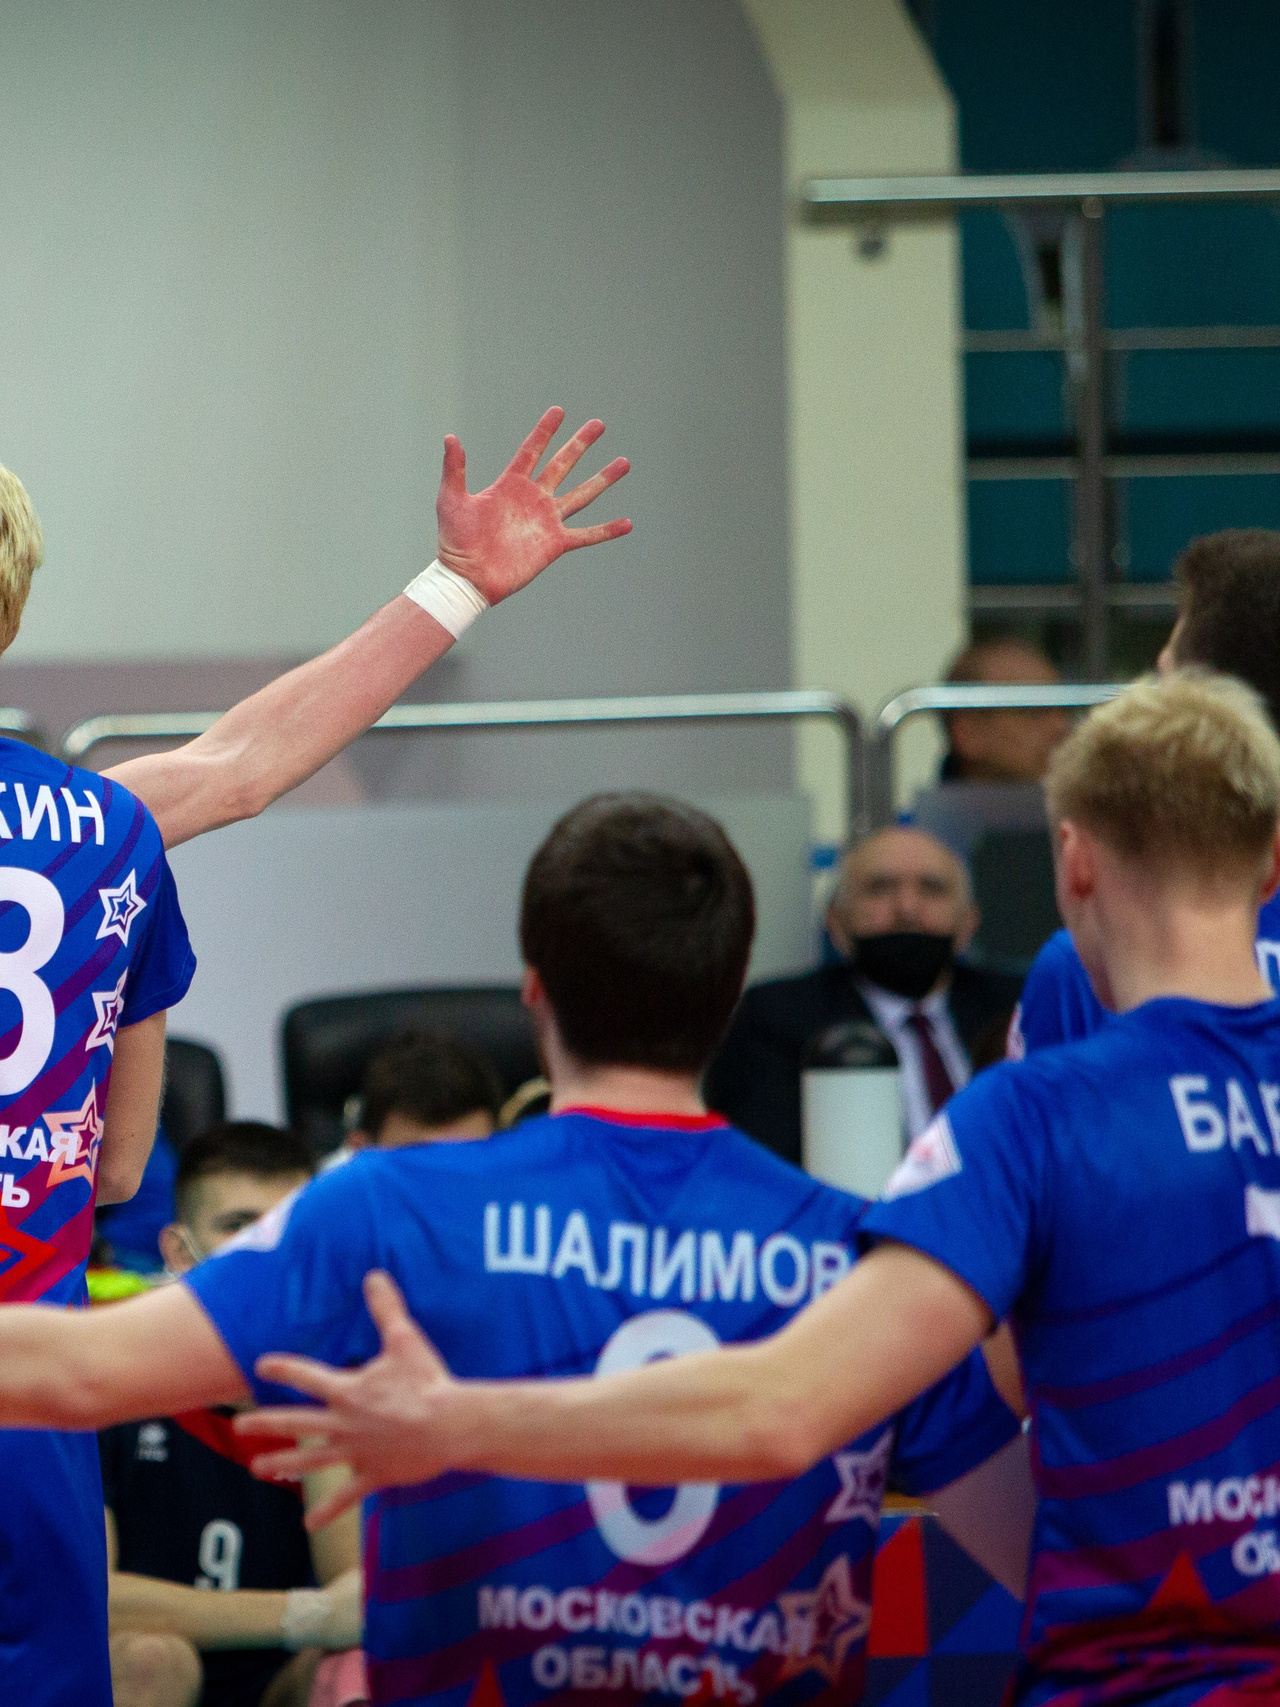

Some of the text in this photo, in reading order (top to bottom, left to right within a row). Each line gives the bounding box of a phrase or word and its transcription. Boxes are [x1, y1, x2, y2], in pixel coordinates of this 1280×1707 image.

[484, 1202, 850, 1306] ШАЛИМОВ
[194, 1518, 243, 1590] 9
[477, 1586, 817, 1656] МОСКОВСКАЯ
[531, 1643, 757, 1704] ОБЛАСТЬ
